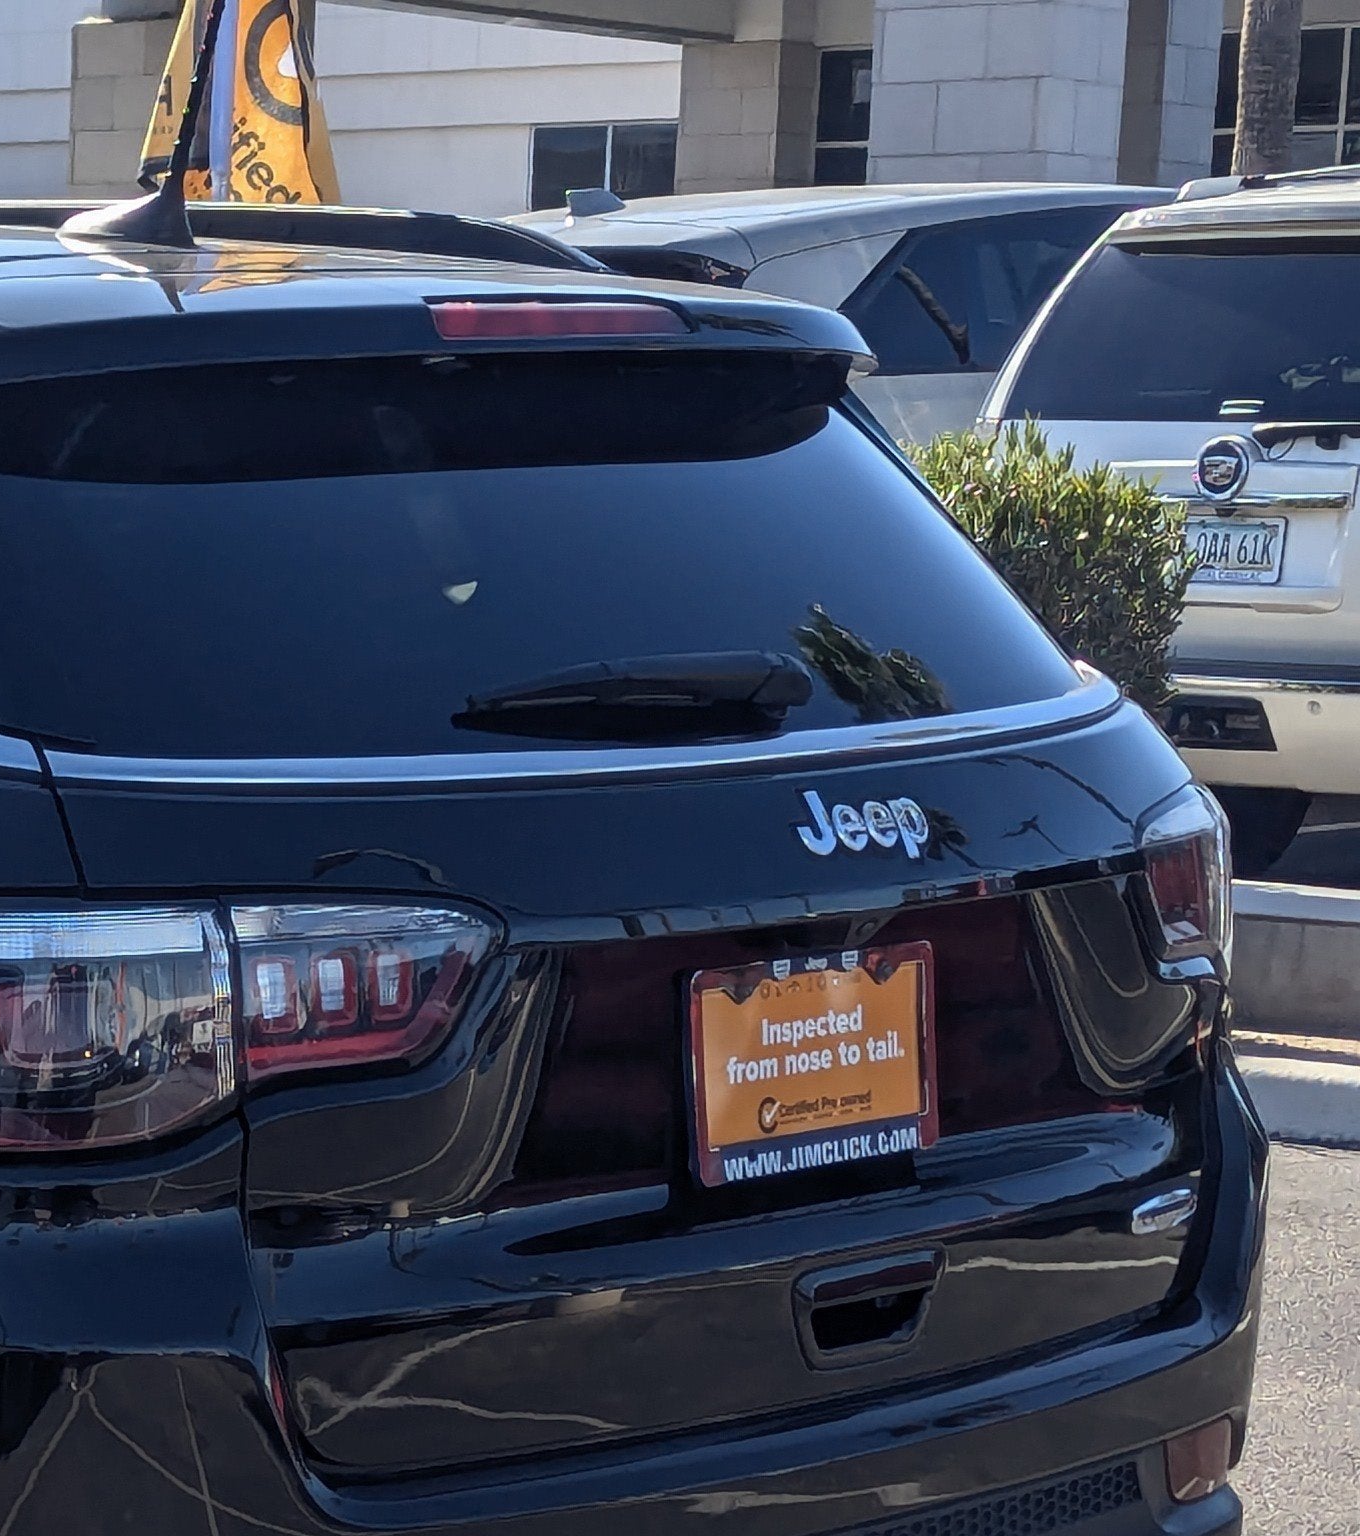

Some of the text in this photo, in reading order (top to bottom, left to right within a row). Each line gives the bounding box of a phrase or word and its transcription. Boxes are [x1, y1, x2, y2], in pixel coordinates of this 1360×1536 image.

[1237, 534, 1273, 565] 61K
[796, 790, 929, 859] Jeep
[762, 1004, 863, 1047] Inspected
[726, 1030, 905, 1085] from nose to tail.
[724, 1126, 919, 1182] WWW.JIMCLICK.COM
